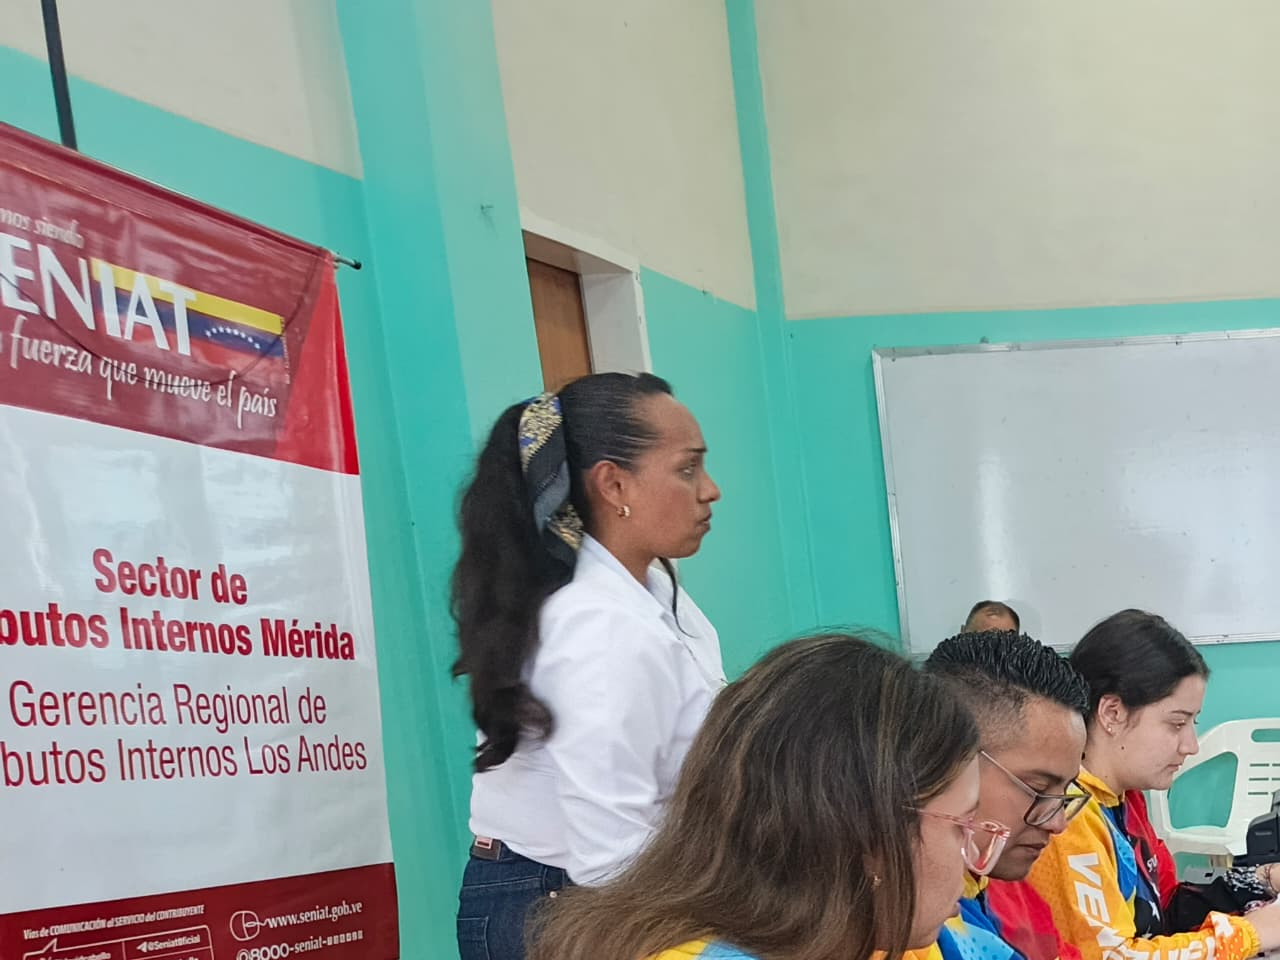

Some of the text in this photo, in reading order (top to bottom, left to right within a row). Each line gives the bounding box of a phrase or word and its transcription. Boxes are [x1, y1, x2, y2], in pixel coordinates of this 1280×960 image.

[10, 313, 278, 429] fuerza que mueve el país
[92, 548, 248, 605] Sector de
[120, 606, 253, 656] Internos
[260, 618, 356, 660] Mérida
[9, 680, 327, 733] Gerencia Regional de
[0, 734, 368, 786] butos Internos Los Andes
[268, 900, 363, 928] www.seniat.gob.ve
